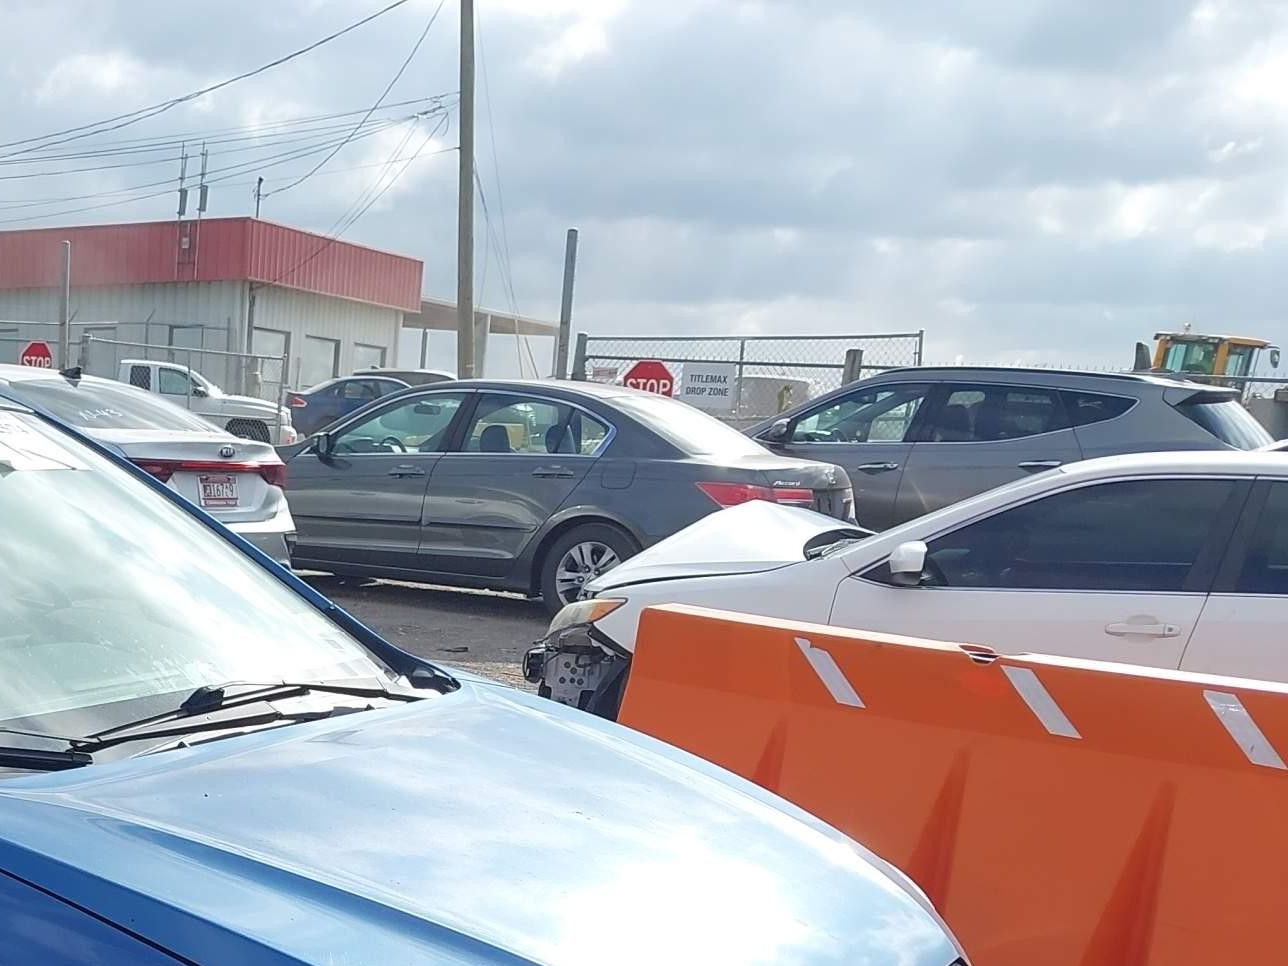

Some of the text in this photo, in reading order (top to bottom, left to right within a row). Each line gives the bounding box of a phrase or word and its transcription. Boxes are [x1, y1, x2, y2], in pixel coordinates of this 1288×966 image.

[23, 355, 51, 368] STOP
[689, 374, 728, 384] TITLEMAX
[626, 378, 671, 394] STOP
[685, 386, 729, 397] DROP ZONE
